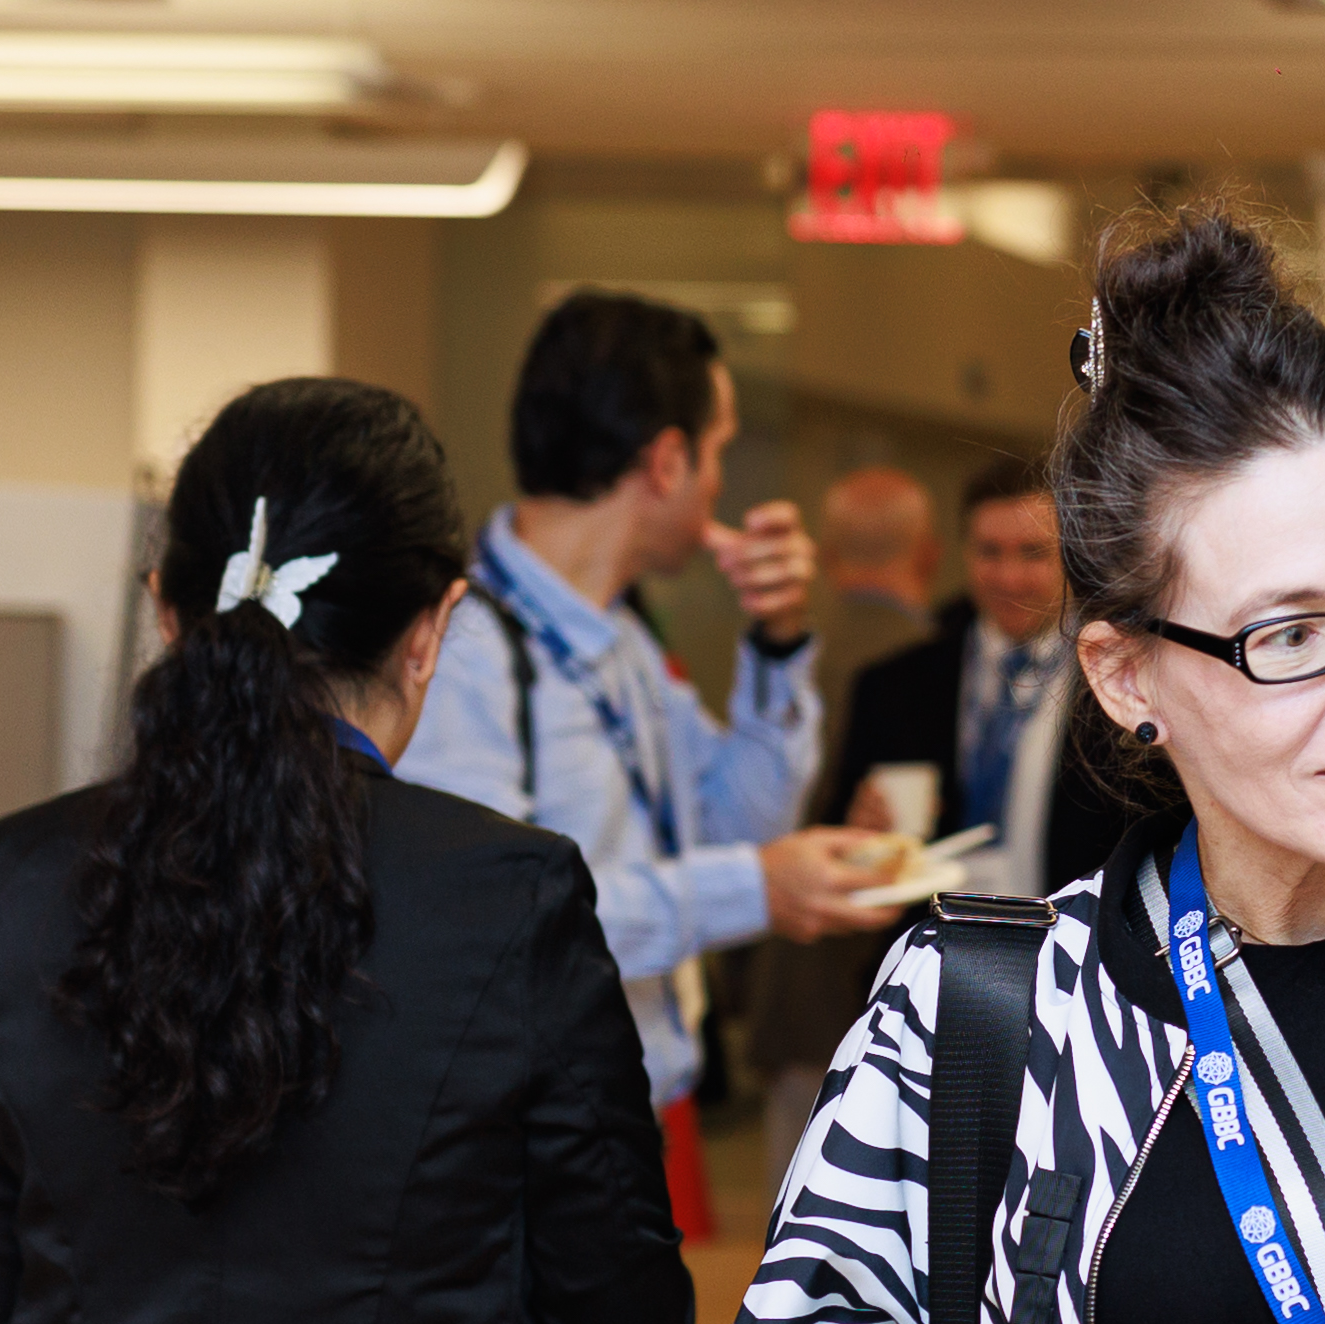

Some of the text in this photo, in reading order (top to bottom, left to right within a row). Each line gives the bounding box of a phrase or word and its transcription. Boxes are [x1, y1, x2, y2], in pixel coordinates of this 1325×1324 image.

[1178, 935, 1212, 1001] GBBC
[1207, 1087, 1245, 1151] GBBC
[1256, 1242, 1311, 1319] GBBC
